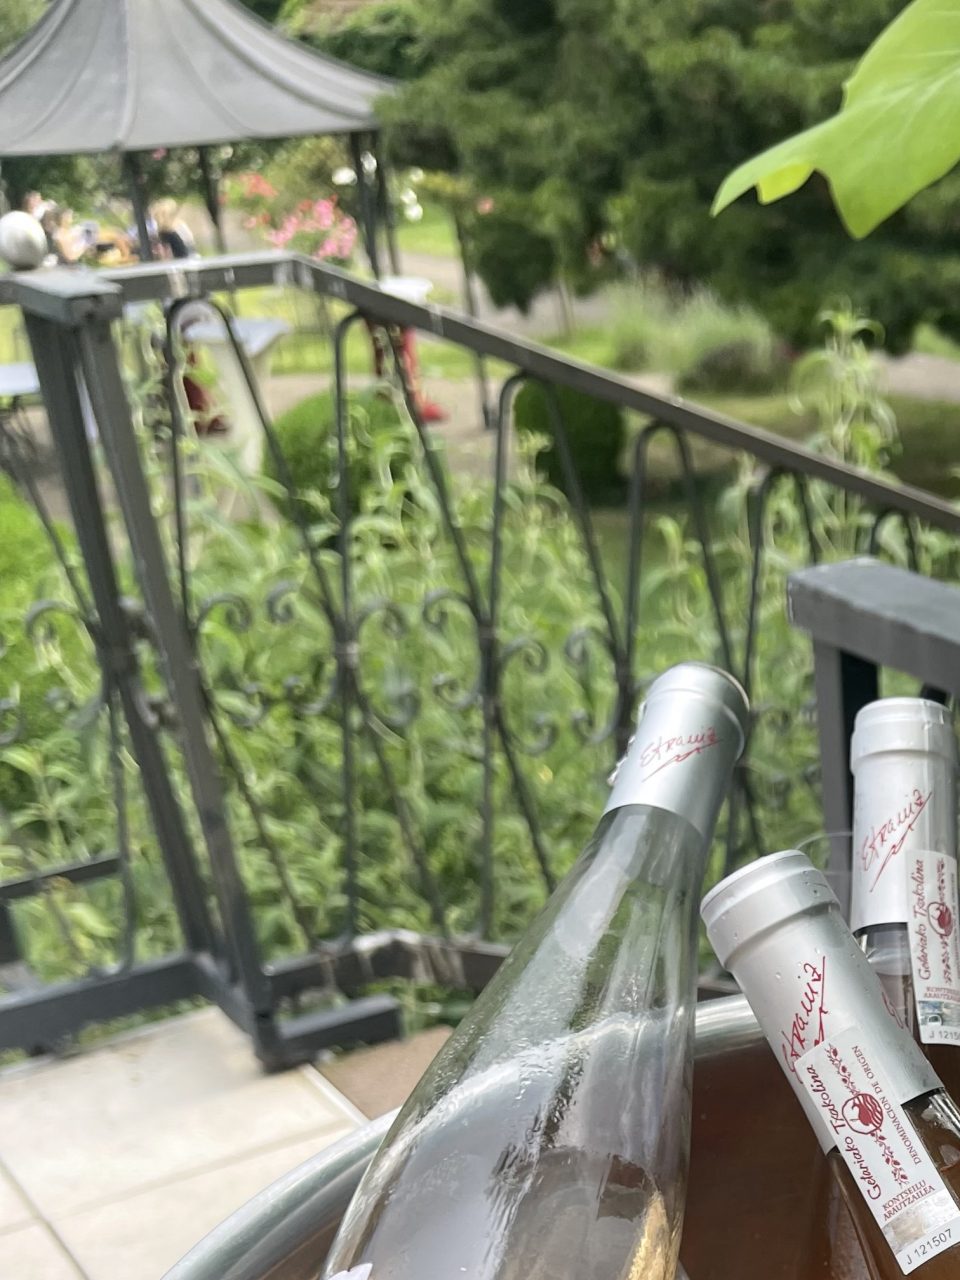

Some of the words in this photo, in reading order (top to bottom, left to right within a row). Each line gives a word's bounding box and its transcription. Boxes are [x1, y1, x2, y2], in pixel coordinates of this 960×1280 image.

[852, 1045, 875, 1079] ORIGEN
[806, 1065, 845, 1135] Txakolina
[871, 1082, 882, 1094] DE
[880, 1097, 921, 1165] DENOMINACION
[845, 1136, 882, 1200] Getariako
[882, 1179, 926, 1210] KONTSEILU
[883, 1185, 935, 1220] ARAUTZAILEA
[906, 1255, 912, 1265] J
[914, 1229, 953, 1259] 121507
